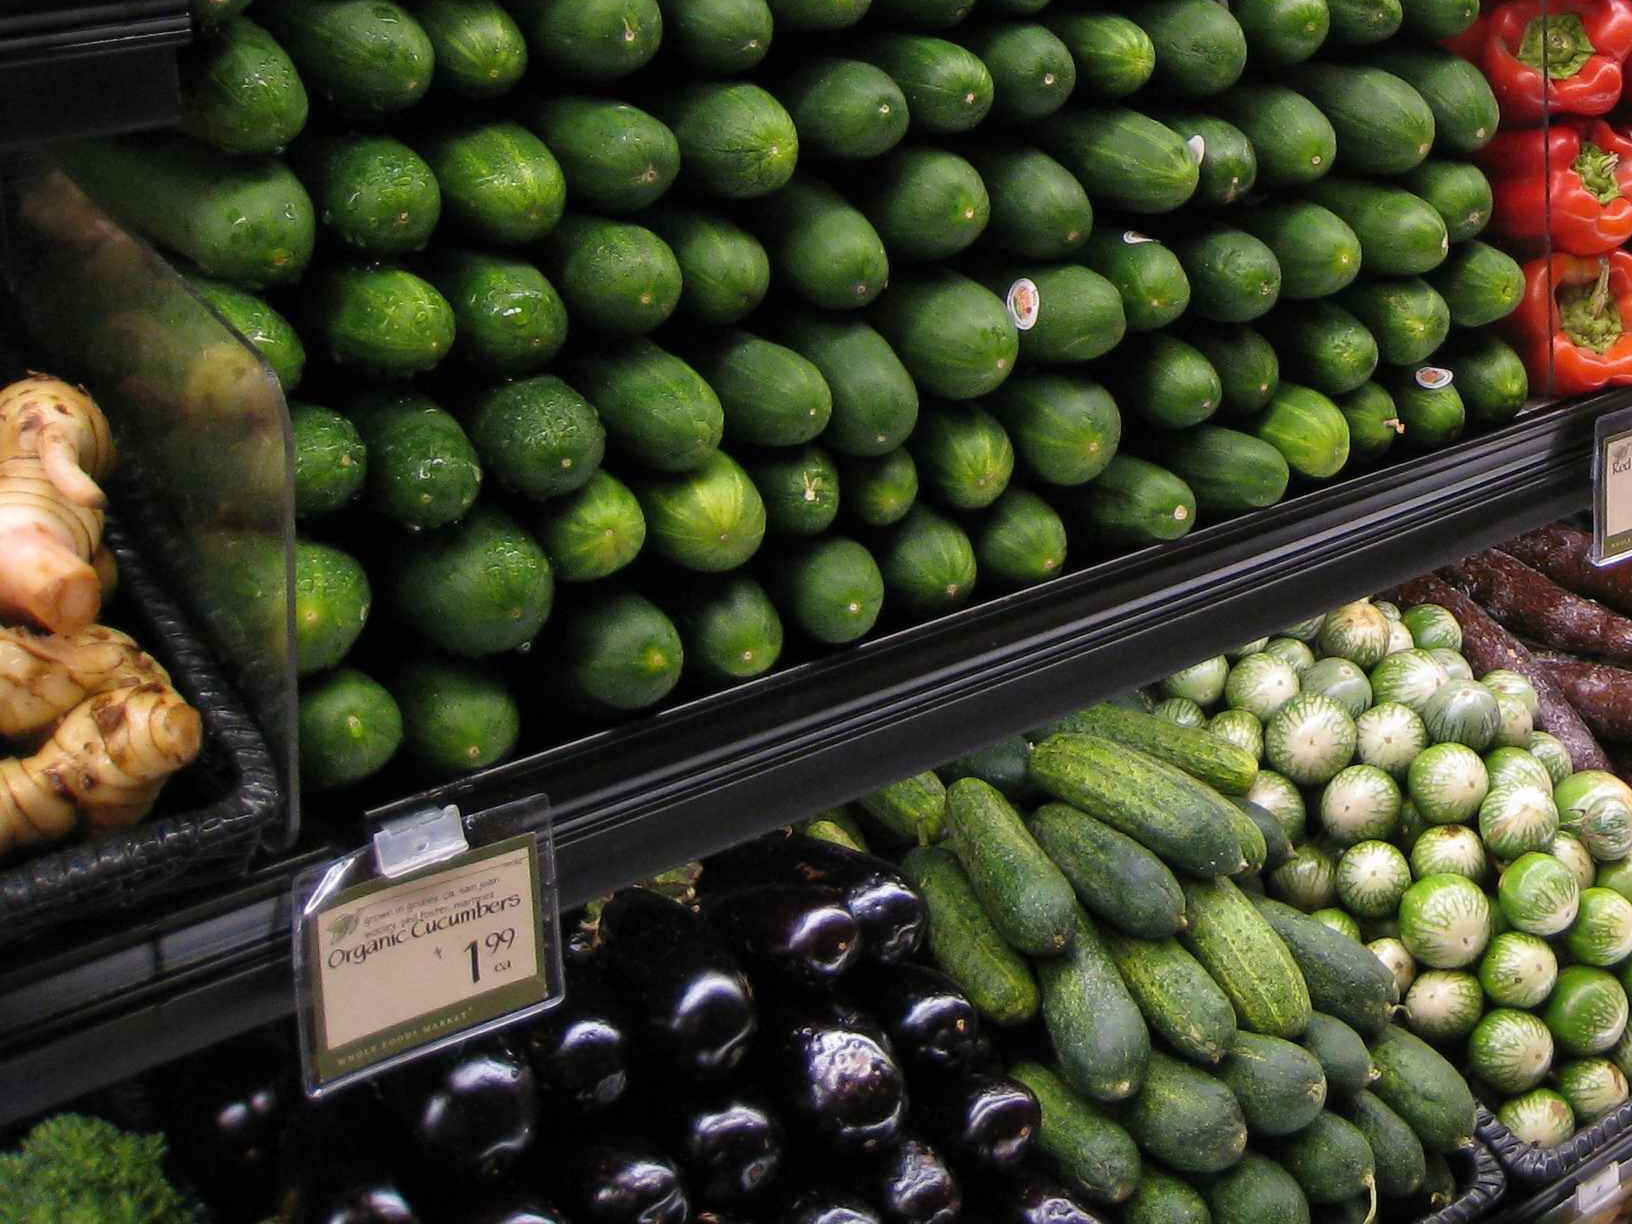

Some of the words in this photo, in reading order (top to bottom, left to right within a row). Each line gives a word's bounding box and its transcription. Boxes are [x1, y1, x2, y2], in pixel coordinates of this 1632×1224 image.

[1612, 455, 1631, 475] Red
[327, 930, 409, 969] Organic
[410, 893, 521, 938] Cucumbers
